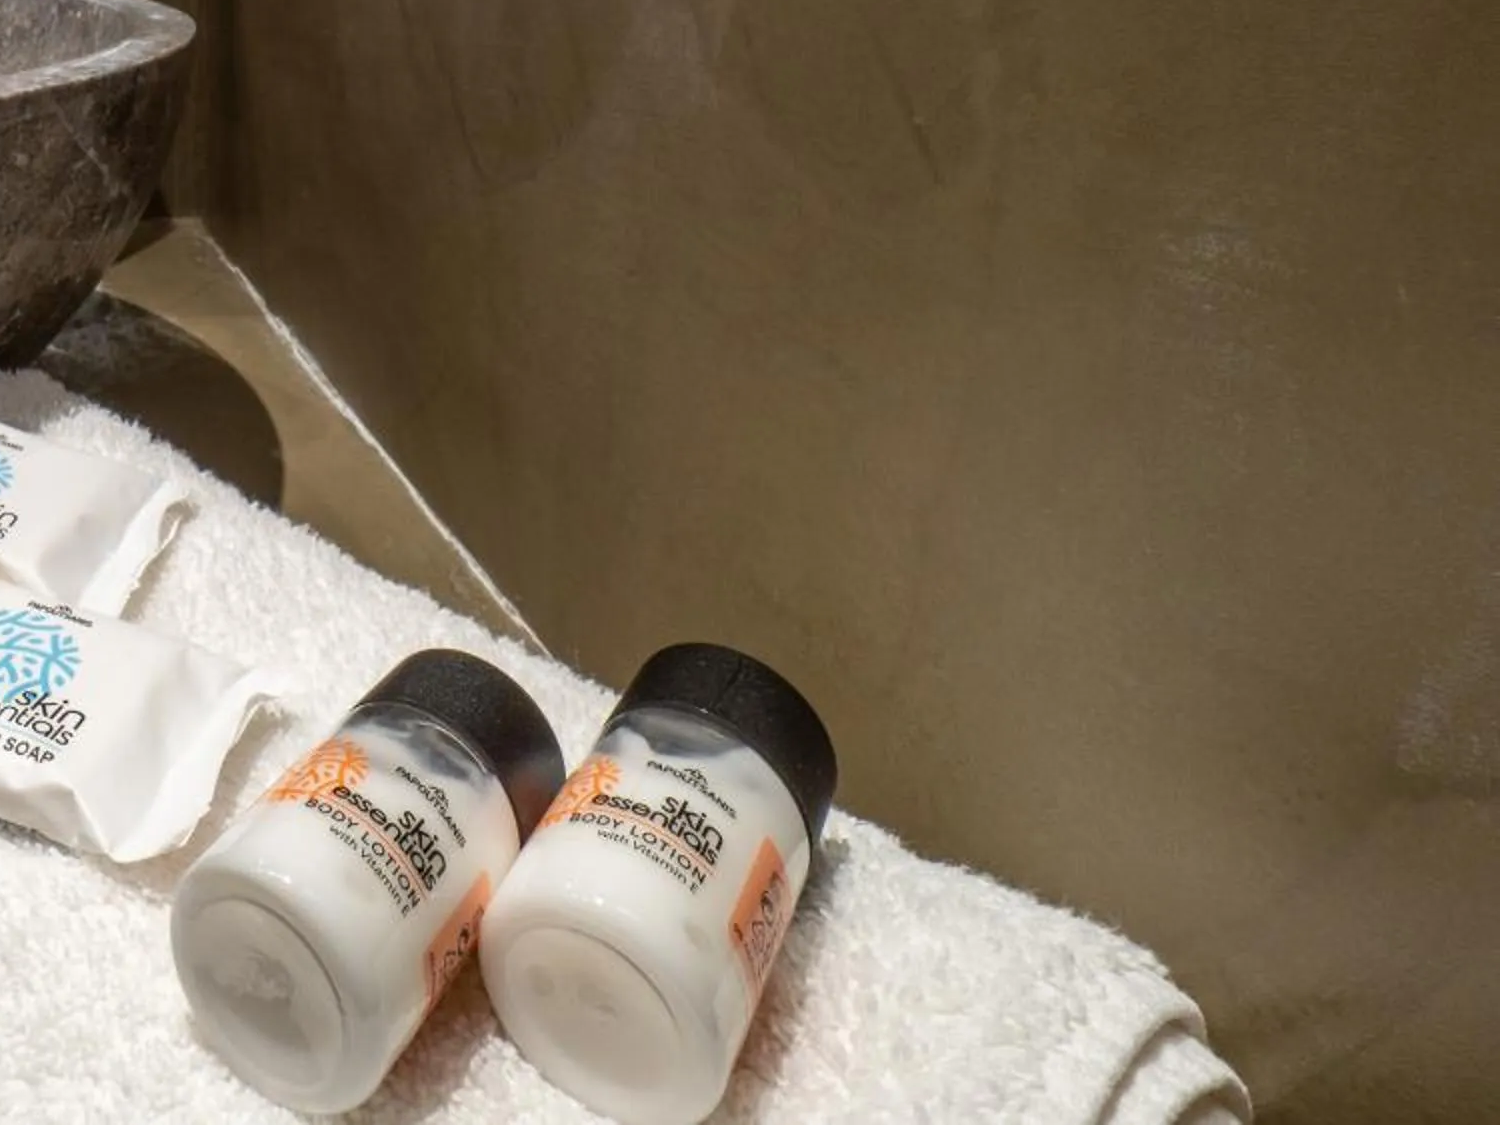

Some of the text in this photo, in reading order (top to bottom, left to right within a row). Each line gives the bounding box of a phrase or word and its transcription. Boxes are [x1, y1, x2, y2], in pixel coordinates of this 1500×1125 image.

[15, 689, 85, 731] skin
[3, 737, 55, 764] SOAP
[304, 797, 421, 908] BODY LOTION
[329, 825, 358, 851] with
[332, 786, 437, 892] essentials
[398, 810, 447, 879] skin
[569, 811, 706, 885] BODY LOTION
[591, 793, 719, 867] essentials
[596, 828, 630, 846] with
[661, 795, 724, 852] skin
